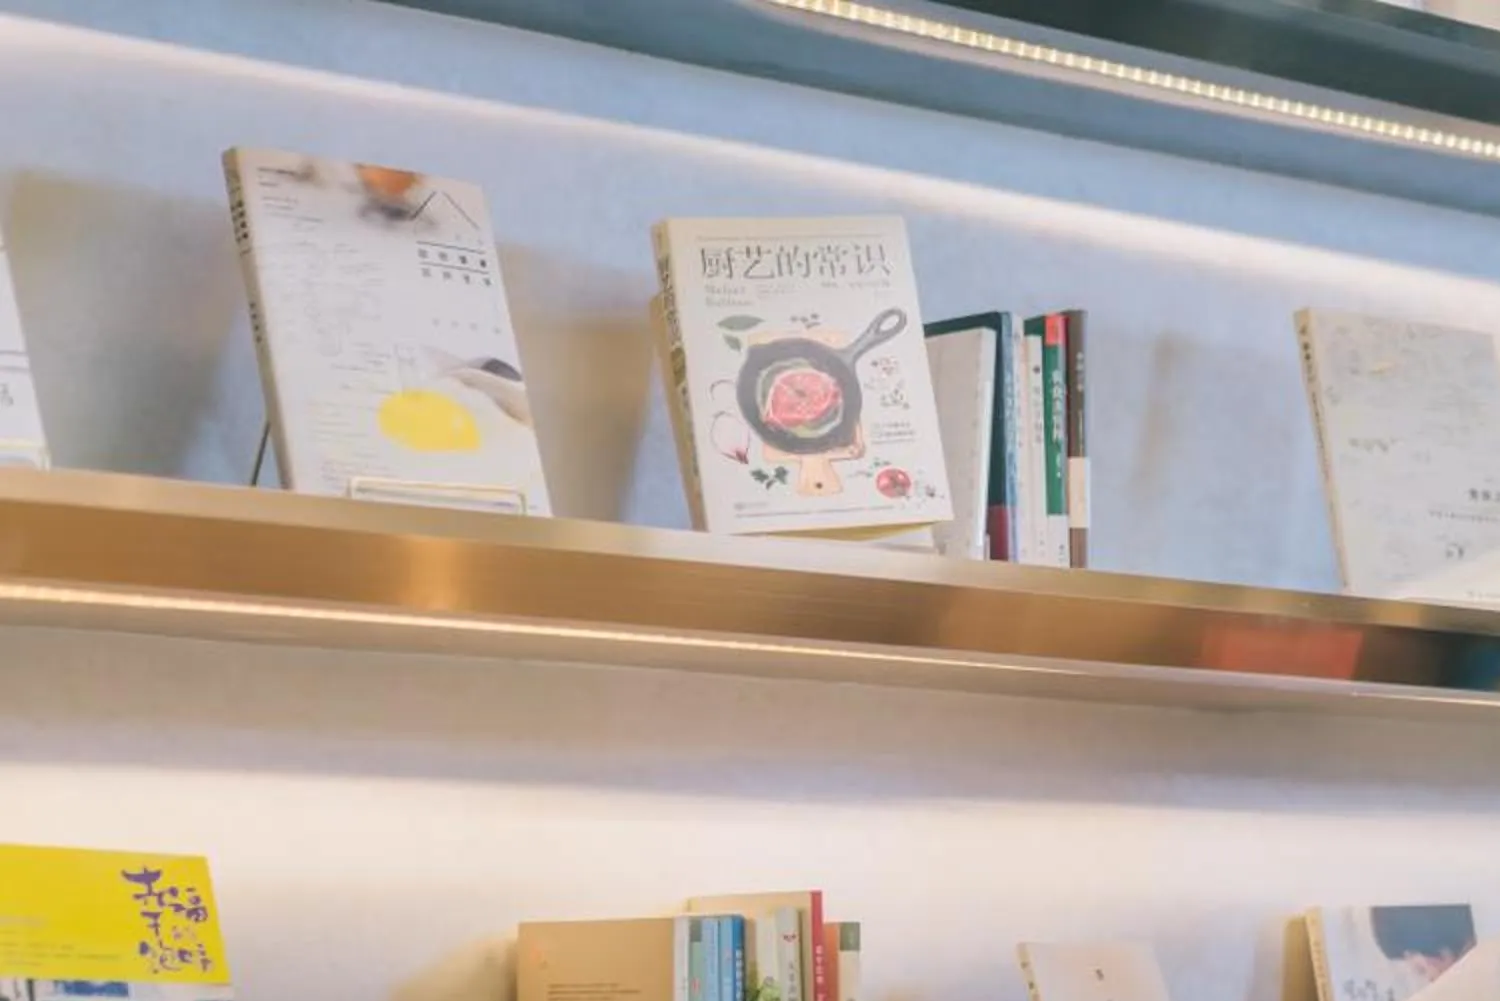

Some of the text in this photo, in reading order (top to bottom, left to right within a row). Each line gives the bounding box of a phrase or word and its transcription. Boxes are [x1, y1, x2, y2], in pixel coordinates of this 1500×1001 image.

[699, 243, 893, 279] 厨艺的常识
